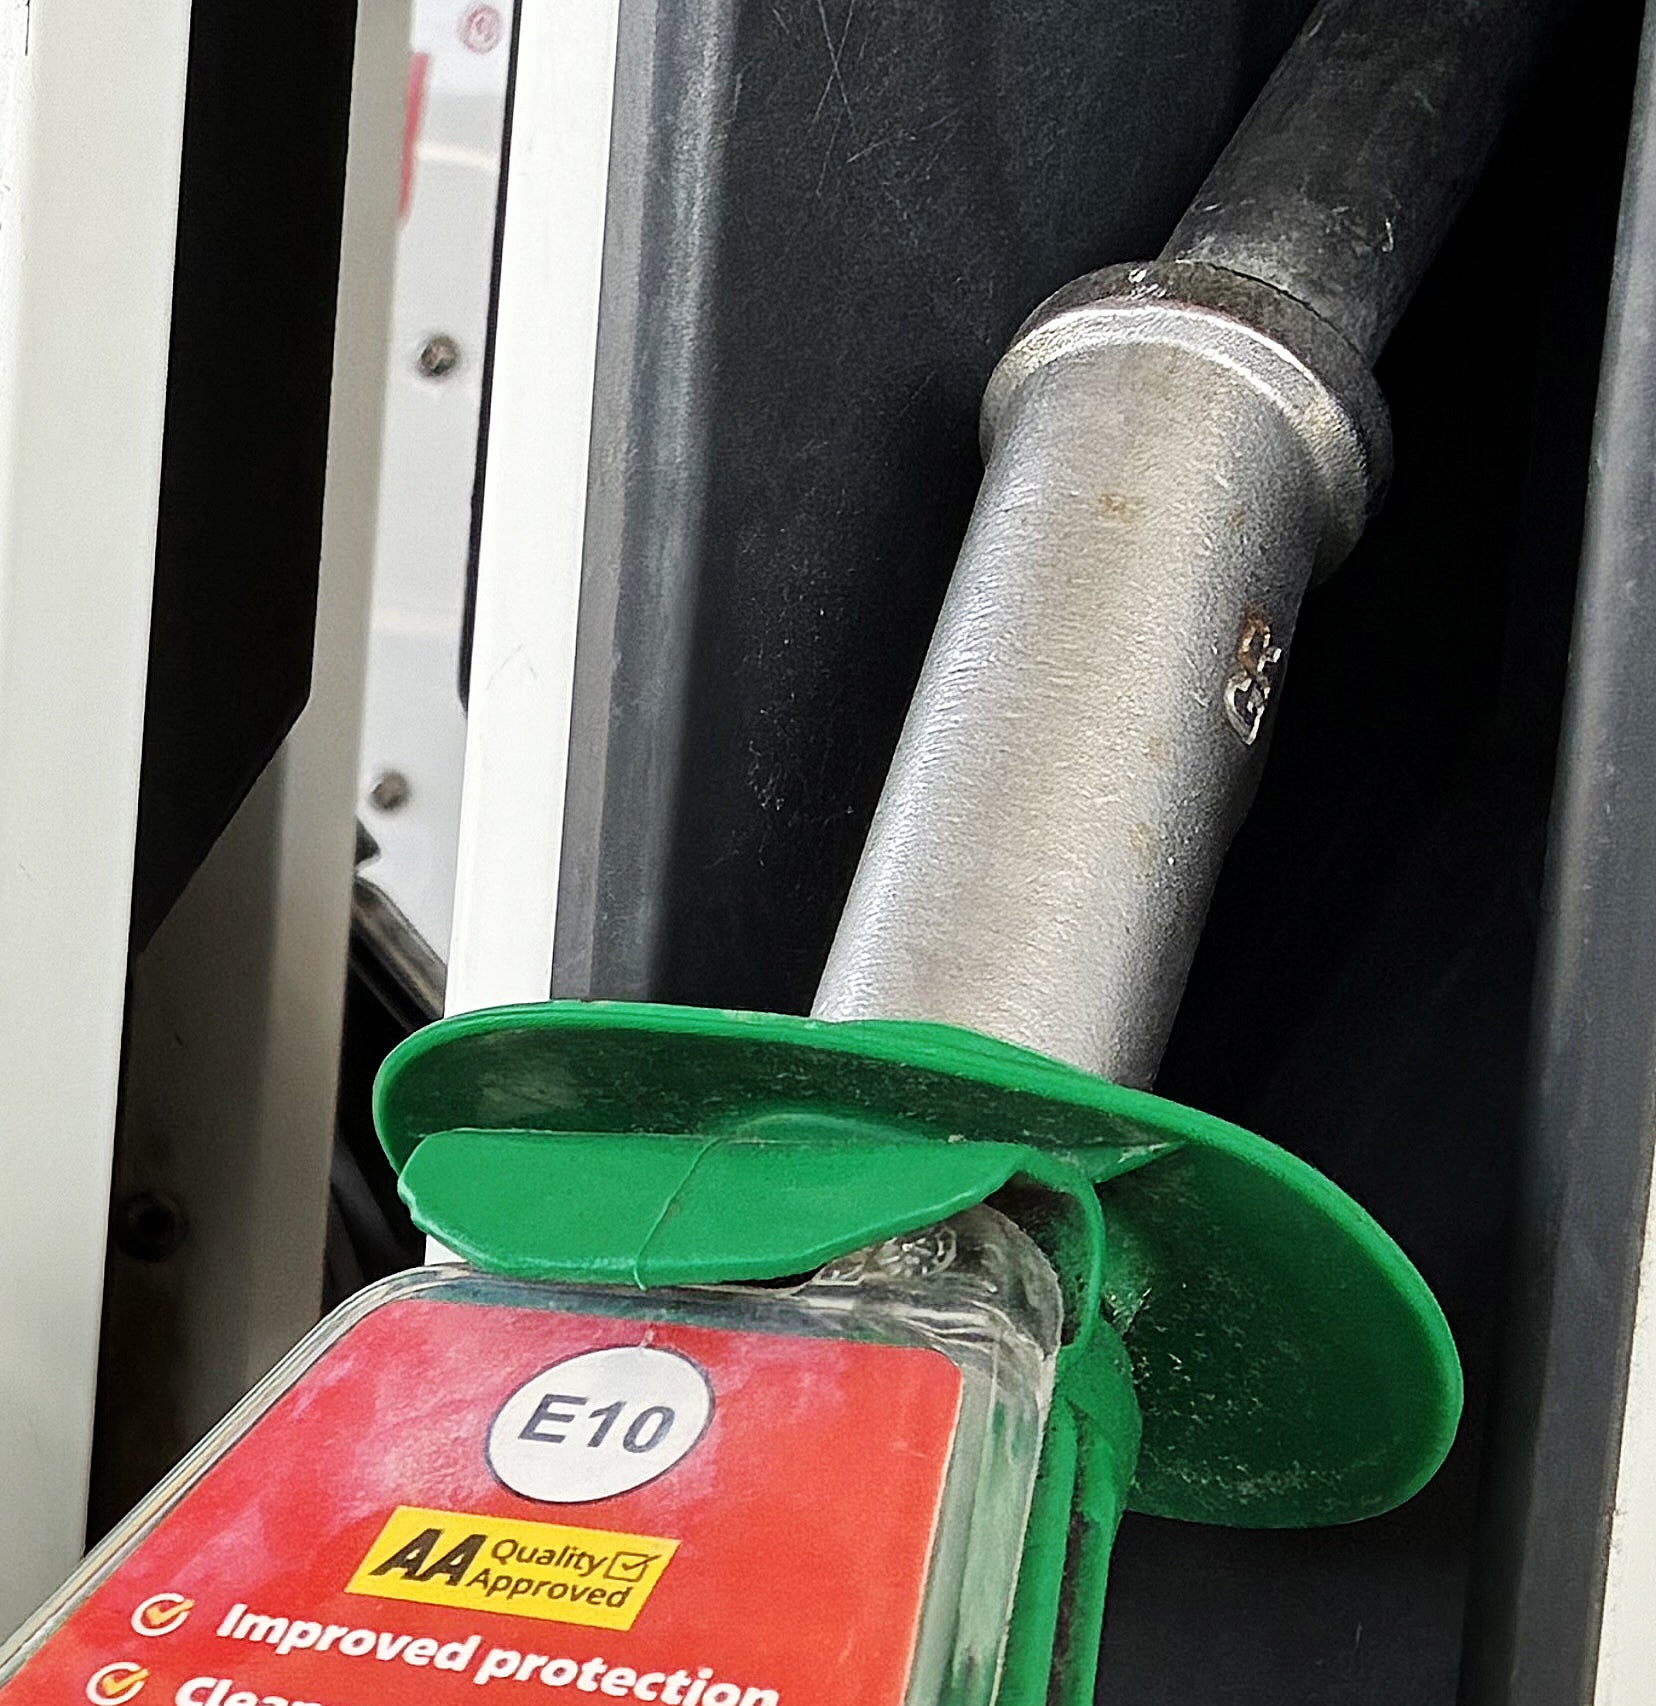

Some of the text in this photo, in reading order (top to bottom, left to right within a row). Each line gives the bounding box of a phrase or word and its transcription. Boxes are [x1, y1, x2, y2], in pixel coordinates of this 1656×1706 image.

[518, 1393, 676, 1454] E10
[367, 1527, 609, 1587] AA Quality
[465, 1568, 634, 1609] Approved
[215, 1602, 483, 1674] Improved
